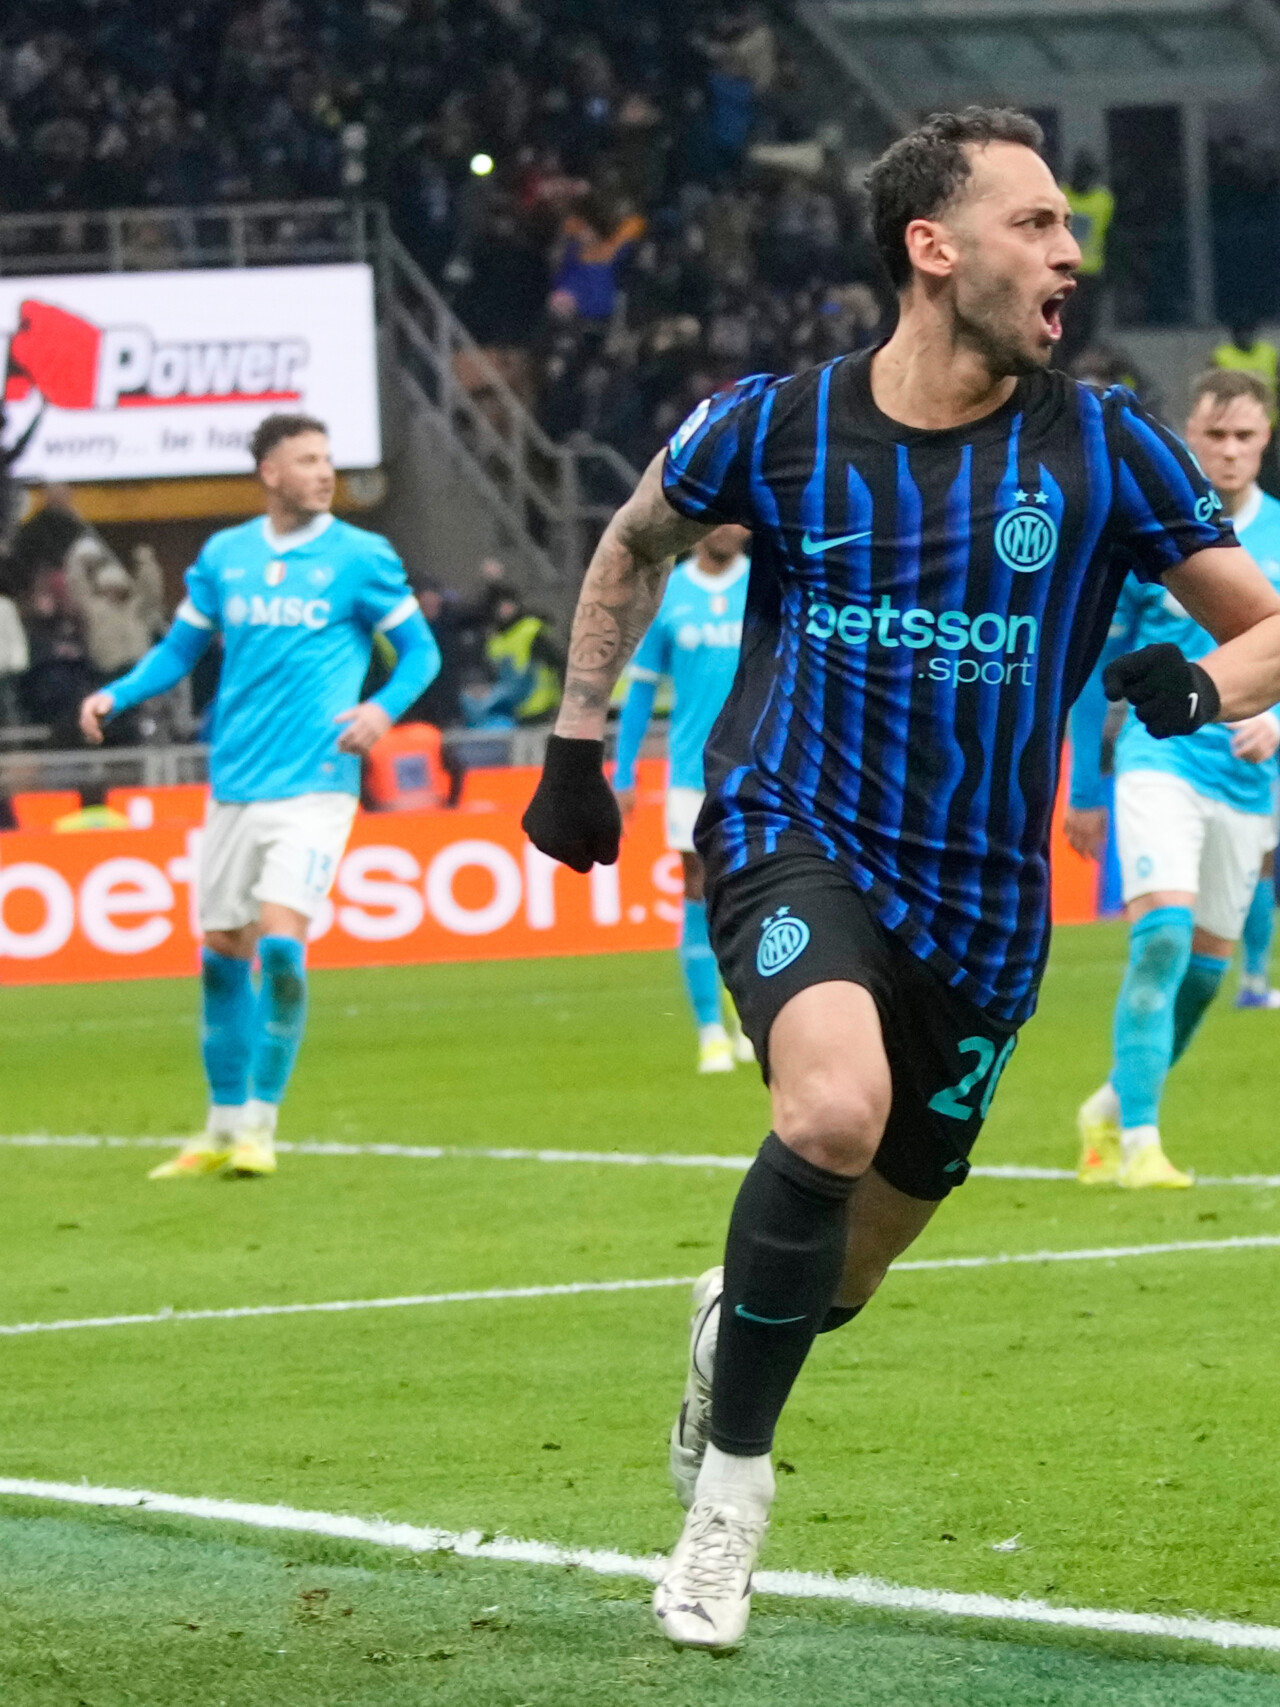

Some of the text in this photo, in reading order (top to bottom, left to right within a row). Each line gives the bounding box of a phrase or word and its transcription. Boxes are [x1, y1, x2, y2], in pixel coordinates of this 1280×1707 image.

[98, 326, 306, 409] Power
[250, 595, 331, 630] MSC
[806, 591, 1038, 654] betsson
[917, 657, 1032, 688] .sport
